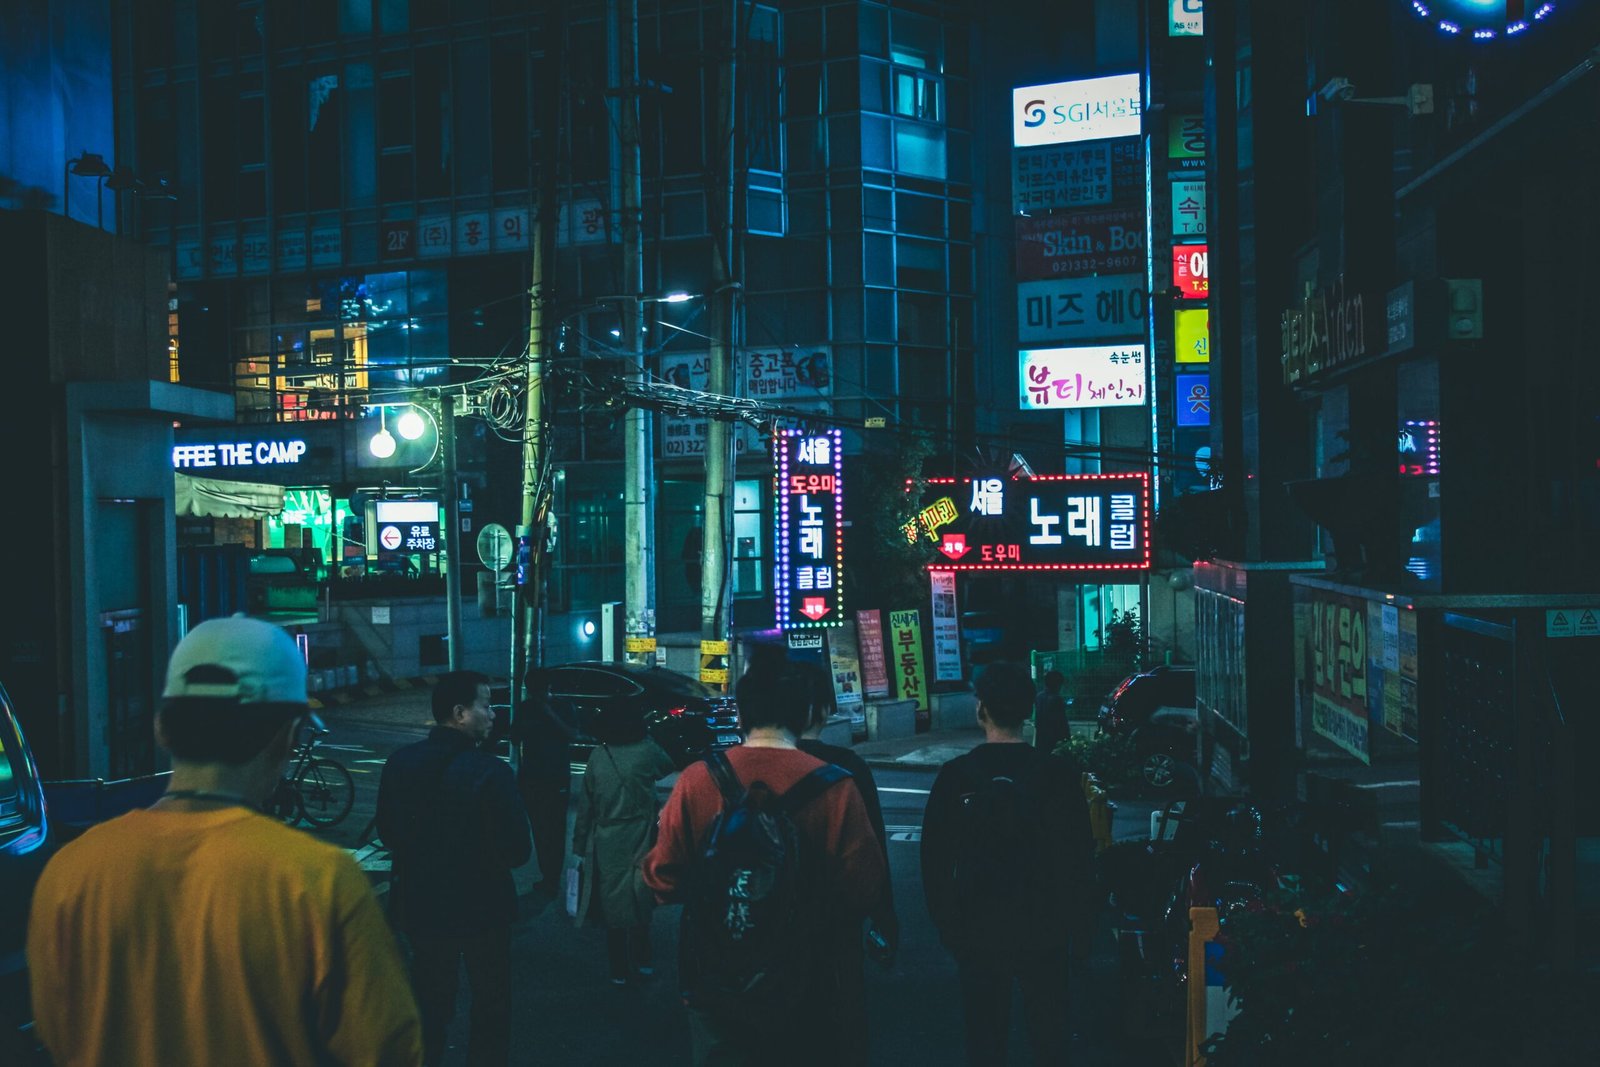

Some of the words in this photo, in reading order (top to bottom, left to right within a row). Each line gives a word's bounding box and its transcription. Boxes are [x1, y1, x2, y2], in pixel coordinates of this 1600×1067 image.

[1042, 229, 1093, 257] Skin
[1108, 225, 1143, 252] Bo
[1026, 293, 1085, 329] 미즈
[751, 352, 796, 378] 중고폰
[1109, 351, 1142, 364] 속눈썹
[1028, 365, 1082, 405] 뷰티
[1088, 378, 1142, 400] 체인지
[217, 443, 253, 466] THE
[255, 440, 306, 465] CAMP
[798, 437, 831, 465] 서울
[790, 475, 836, 494] 도우미
[969, 478, 1004, 516] 서울
[410, 525, 430, 537] 유료
[799, 494, 824, 559] 노래
[1029, 495, 1101, 547] 노래
[1110, 494, 1136, 550] 클럽
[406, 536, 436, 550] 주차장
[981, 544, 1020, 562] 도우미
[796, 566, 832, 590] 클럽
[890, 610, 919, 629] 신세계
[897, 629, 921, 700] 부동산
